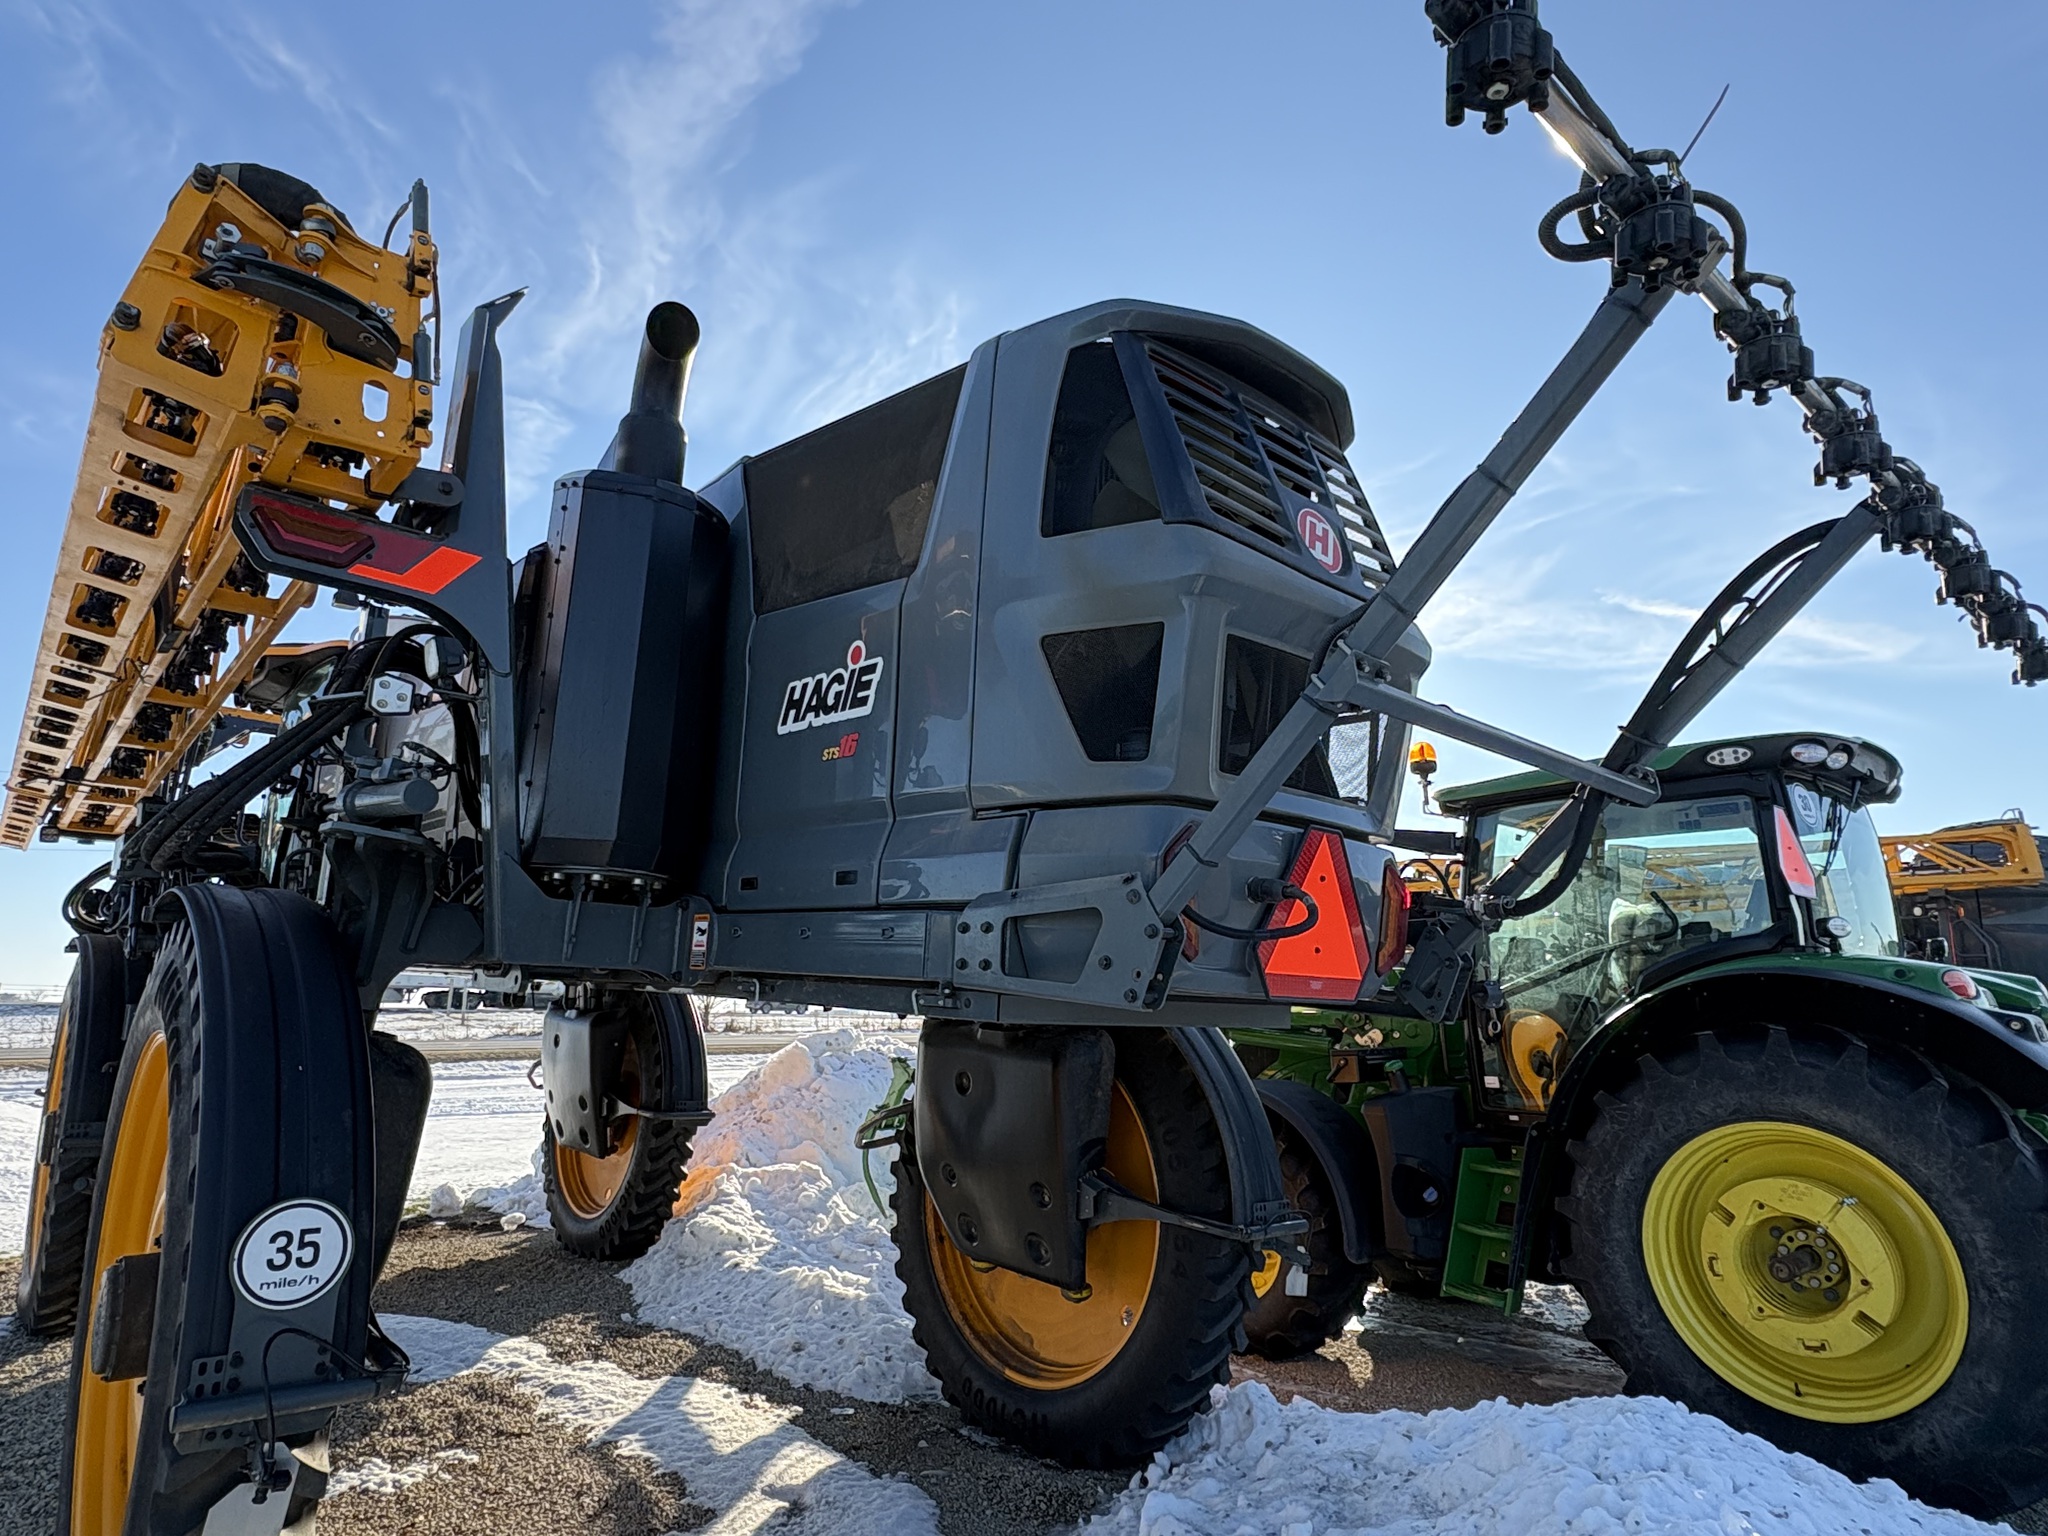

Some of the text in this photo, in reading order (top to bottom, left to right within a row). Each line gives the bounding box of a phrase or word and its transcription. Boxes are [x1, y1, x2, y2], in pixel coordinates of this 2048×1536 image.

[779, 644, 880, 729] HAGIE
[822, 733, 859, 760] STS16
[266, 1227, 322, 1272] 35
[259, 1274, 320, 1291] mile/h
